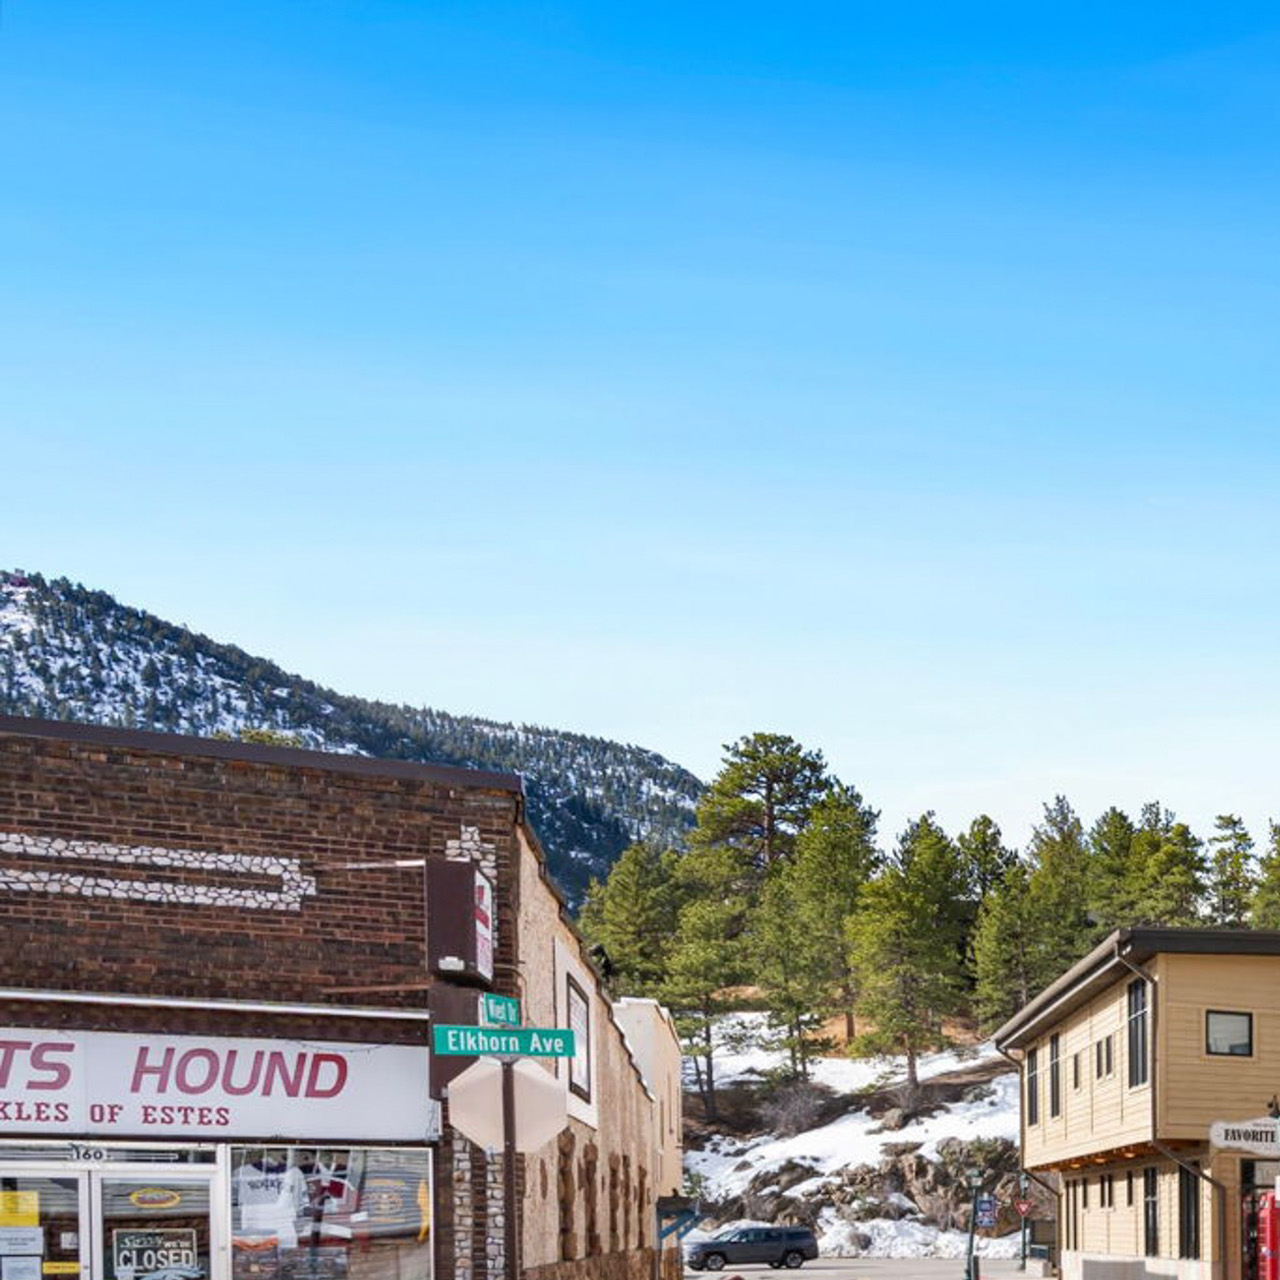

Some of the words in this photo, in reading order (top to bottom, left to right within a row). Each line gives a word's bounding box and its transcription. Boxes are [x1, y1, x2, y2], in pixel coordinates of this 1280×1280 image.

[447, 1030, 519, 1052] Elkhorn
[530, 1033, 564, 1053] Ave
[130, 1046, 348, 1098] HOUND
[90, 1104, 123, 1124] OF
[142, 1105, 230, 1126] ESTES
[1224, 1128, 1276, 1143] FAVORITE
[76, 1149, 103, 1160] 160
[119, 1249, 193, 1270] CLOSED
